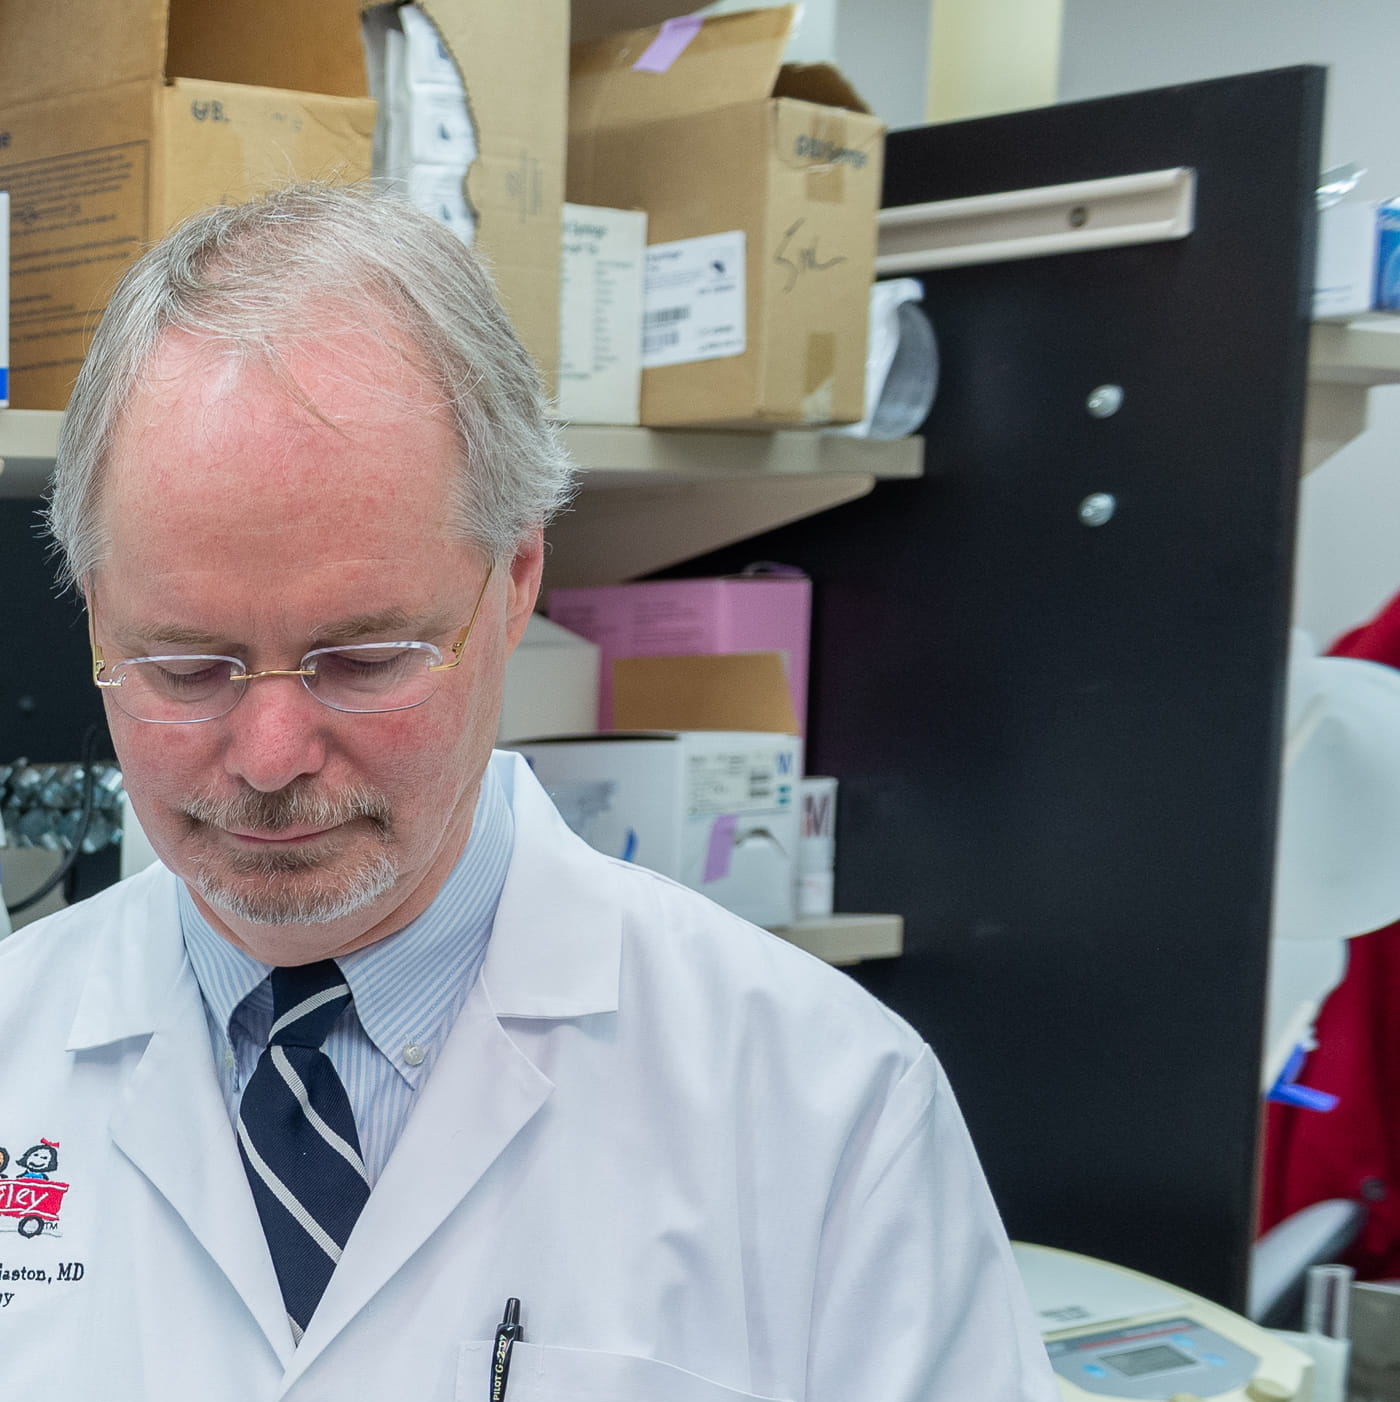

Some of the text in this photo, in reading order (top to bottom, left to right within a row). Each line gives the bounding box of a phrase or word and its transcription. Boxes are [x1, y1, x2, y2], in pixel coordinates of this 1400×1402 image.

[57, 1262, 85, 1281] MD
[495, 1351, 505, 1373] G-2
[493, 1375, 502, 1400] PILOT
